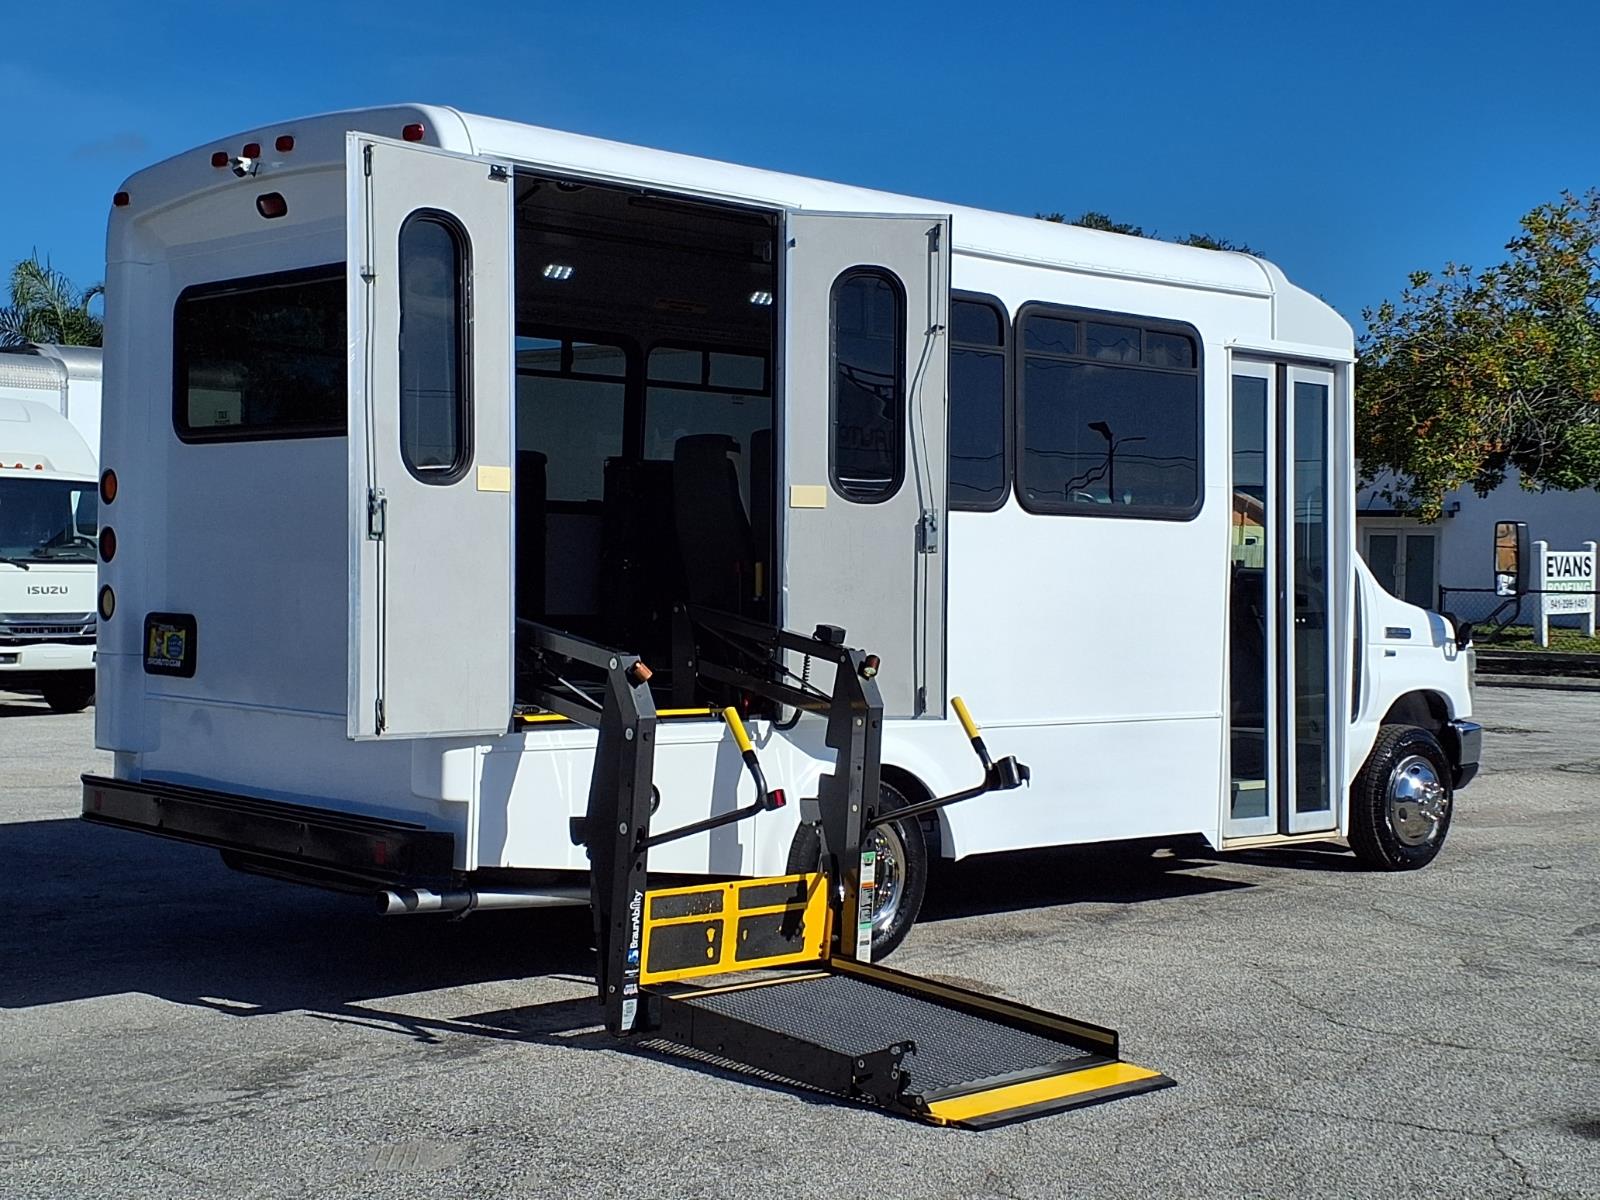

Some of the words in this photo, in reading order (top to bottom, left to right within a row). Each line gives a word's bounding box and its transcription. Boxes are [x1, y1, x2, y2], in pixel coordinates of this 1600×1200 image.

[1547, 556, 1591, 577] EVANS
[27, 585, 69, 595] ISUZU
[1547, 581, 1591, 592] ROOFING
[629, 889, 643, 949] BraunAbility
